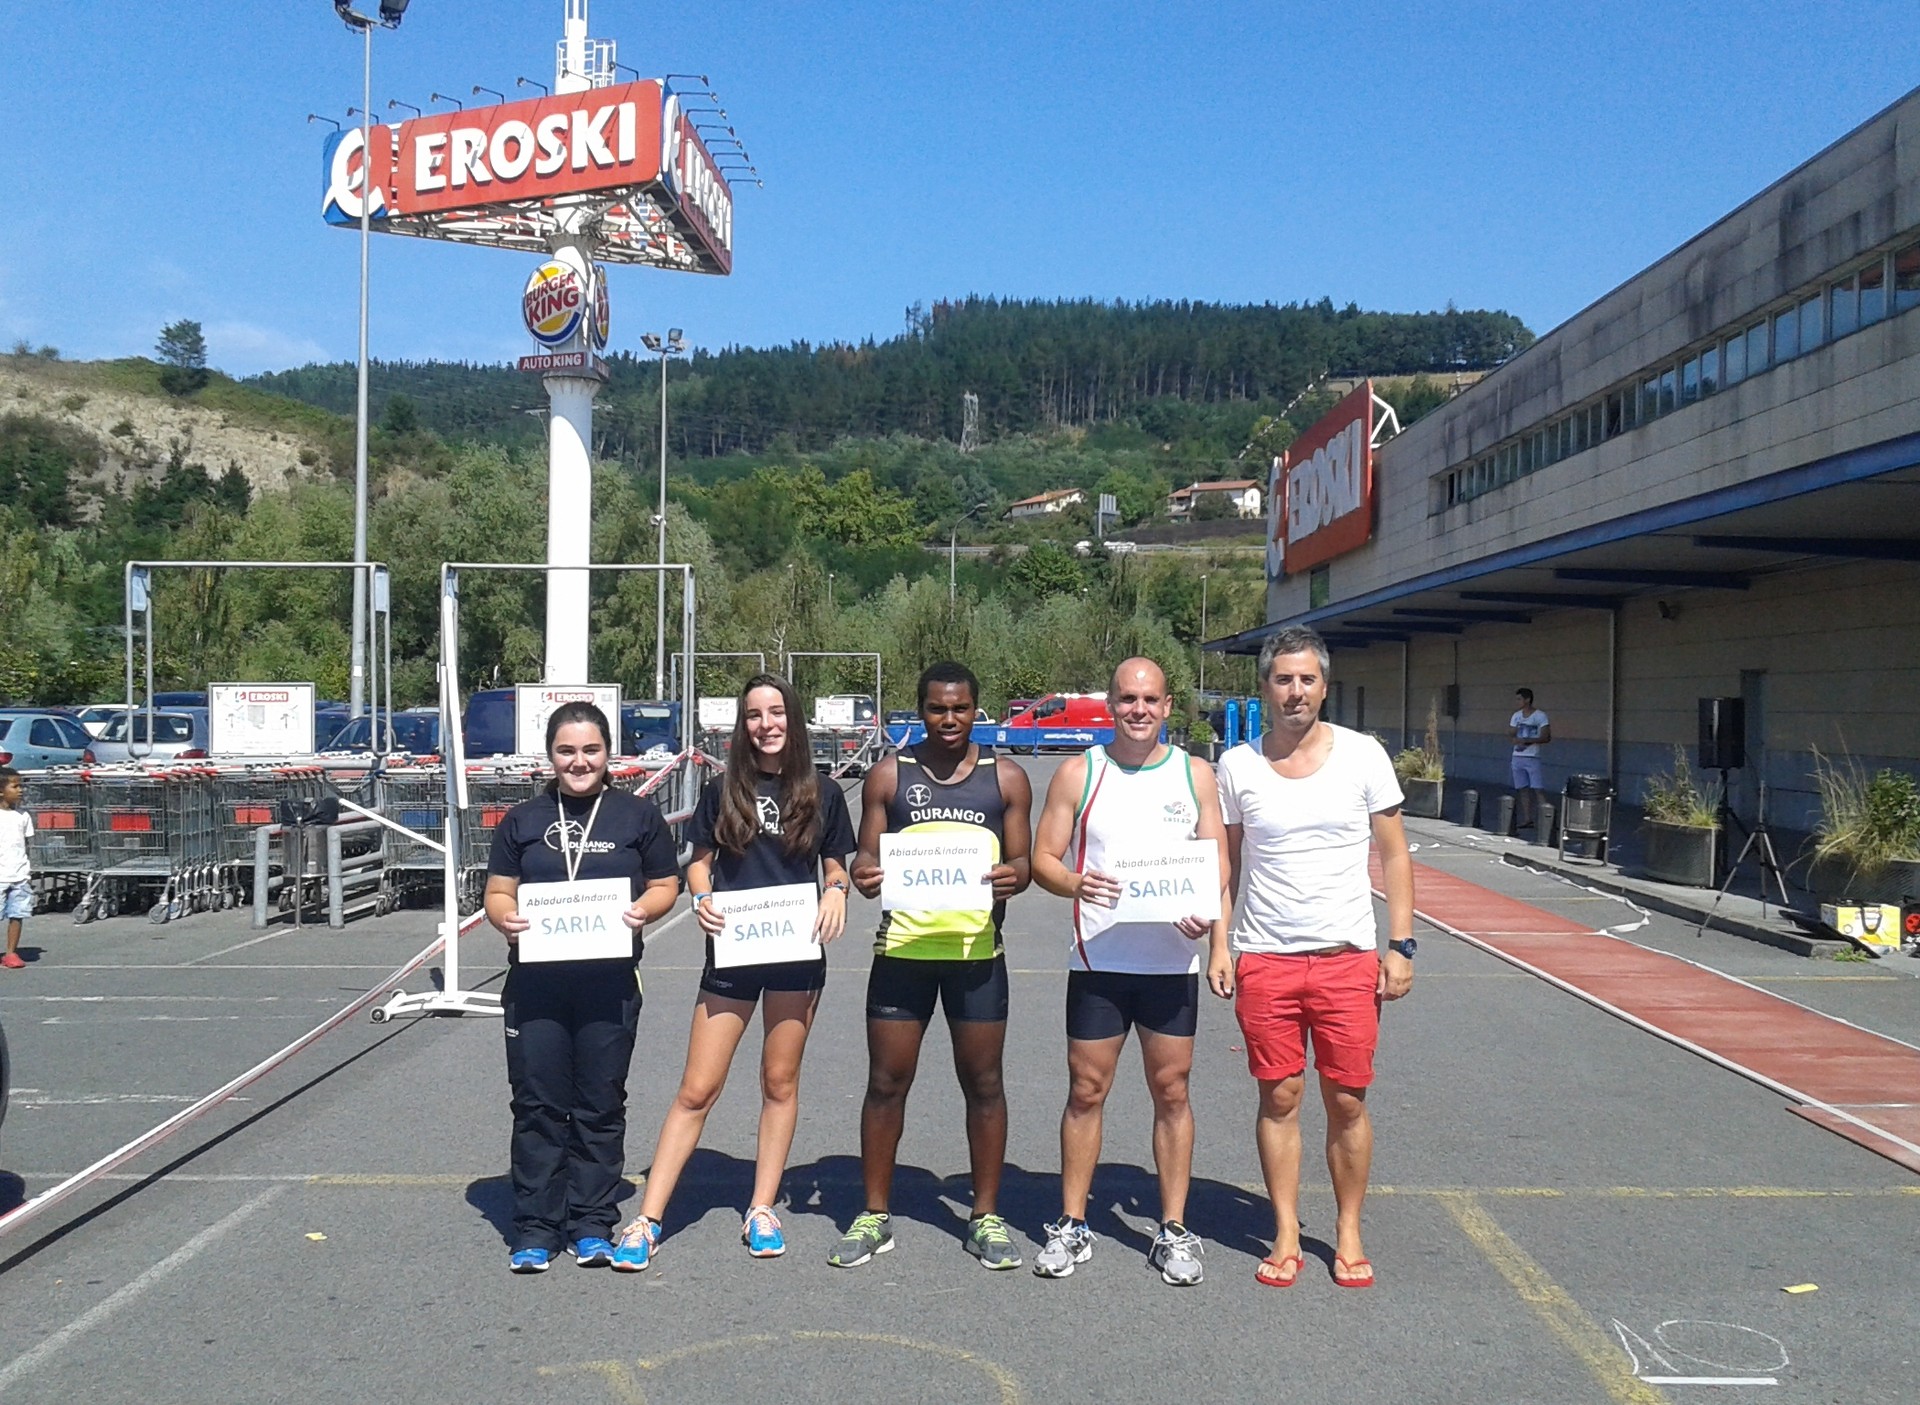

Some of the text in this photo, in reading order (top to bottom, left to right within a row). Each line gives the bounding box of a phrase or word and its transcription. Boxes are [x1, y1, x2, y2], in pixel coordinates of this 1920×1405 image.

[414, 102, 637, 192] EROSKI
[526, 271, 576, 308] BURGER
[528, 286, 580, 329] KING
[522, 353, 582, 370] AUTO KING
[250, 692, 287, 702] EROSKI
[910, 807, 986, 824] DURANGO
[902, 867, 968, 887] SARIA
[1129, 877, 1196, 898] SARIA
[541, 914, 607, 935] SARIA
[734, 919, 796, 942] SARIA
